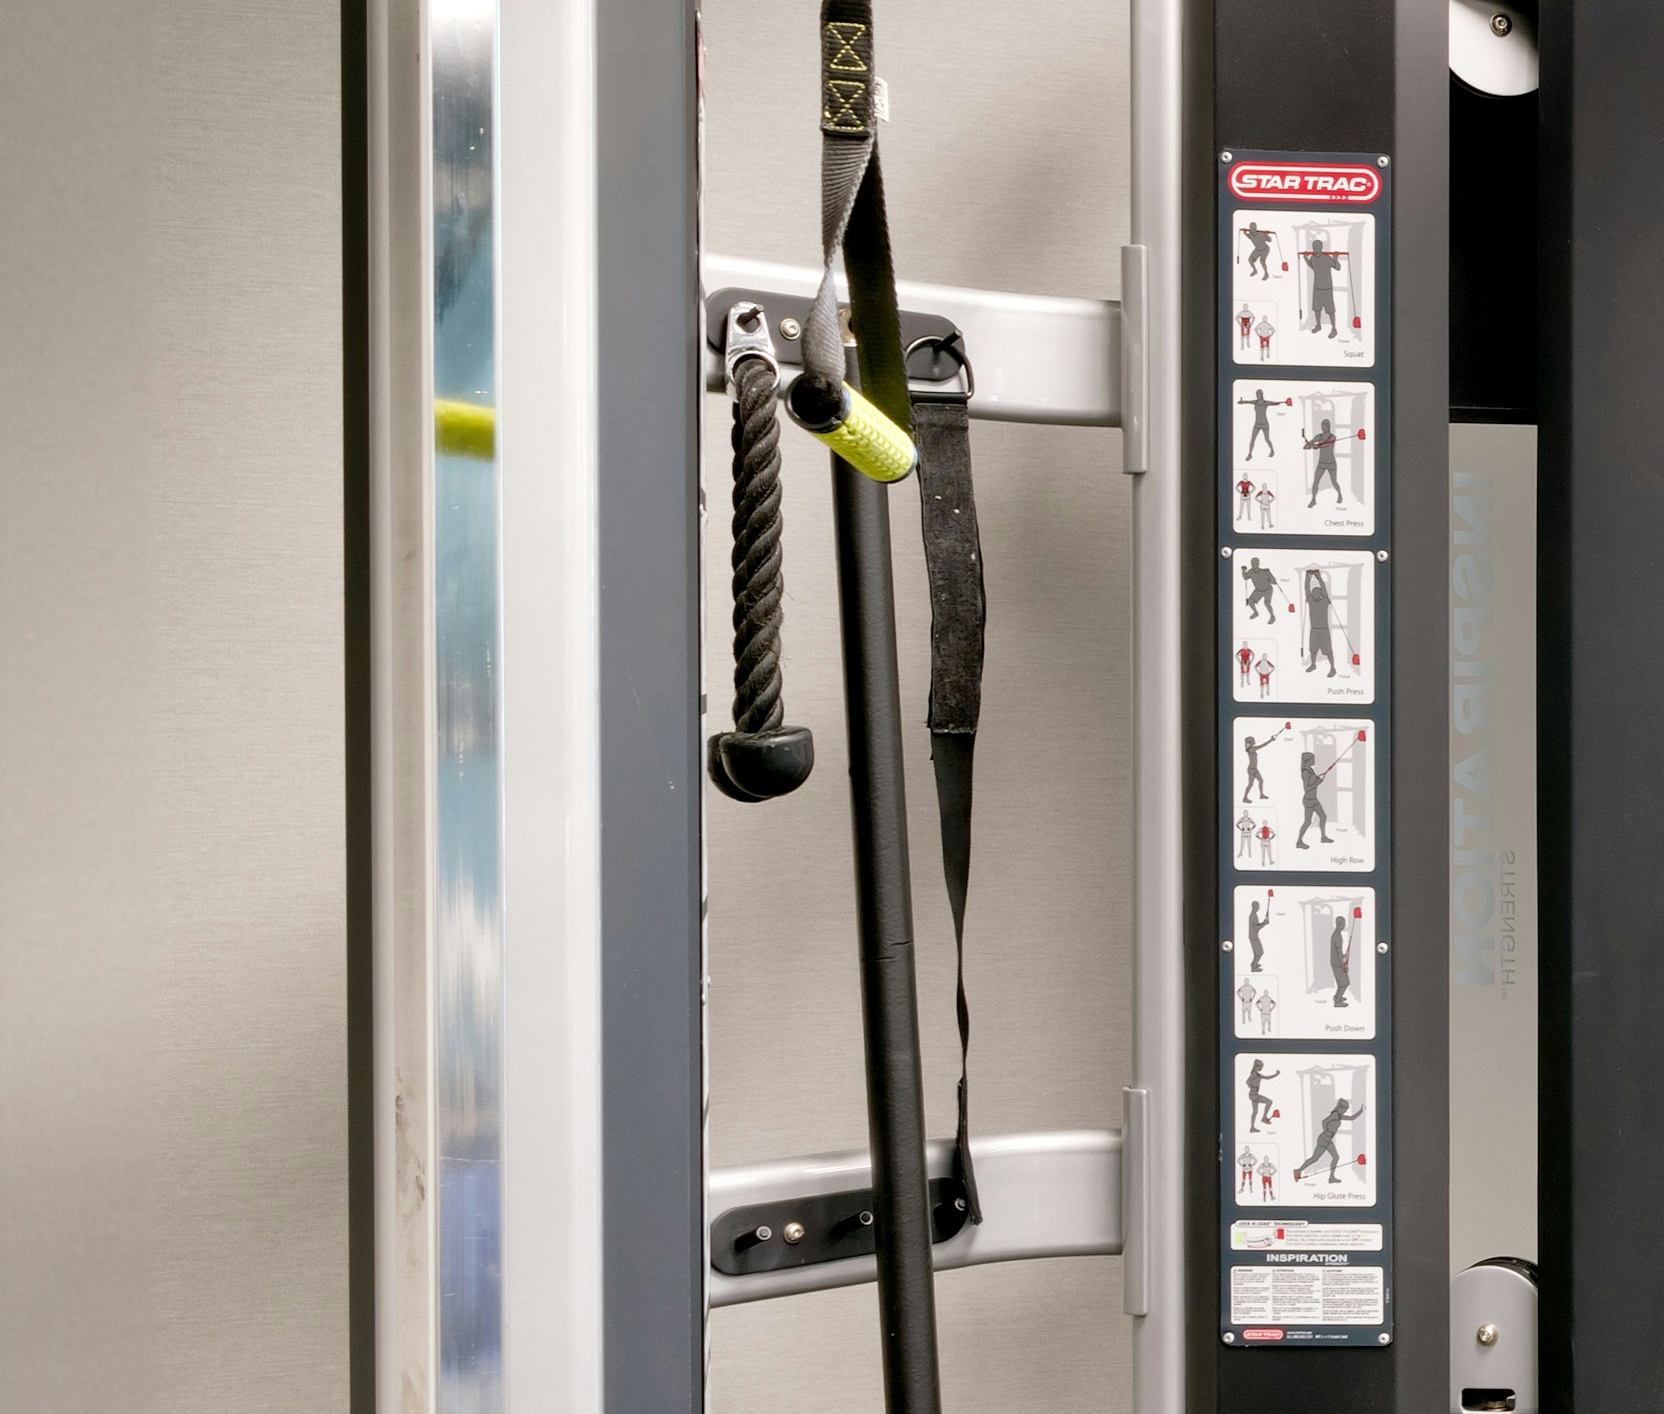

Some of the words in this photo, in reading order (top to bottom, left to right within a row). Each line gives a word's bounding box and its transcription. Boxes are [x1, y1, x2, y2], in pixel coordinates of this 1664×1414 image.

[1241, 174, 1301, 189] STAR
[1304, 176, 1367, 192] TRAC
[1343, 350, 1364, 358] Squat
[1324, 519, 1343, 527] Chest
[1344, 520, 1364, 528] Press
[1327, 687, 1343, 696] Push
[1344, 688, 1364, 696] Press
[1330, 856, 1347, 865] High
[1325, 1024, 1342, 1032] Push
[1313, 1192, 1326, 1201] Hip
[1327, 1192, 1346, 1200] Glute
[1266, 1253, 1348, 1263] INSPIRATION
